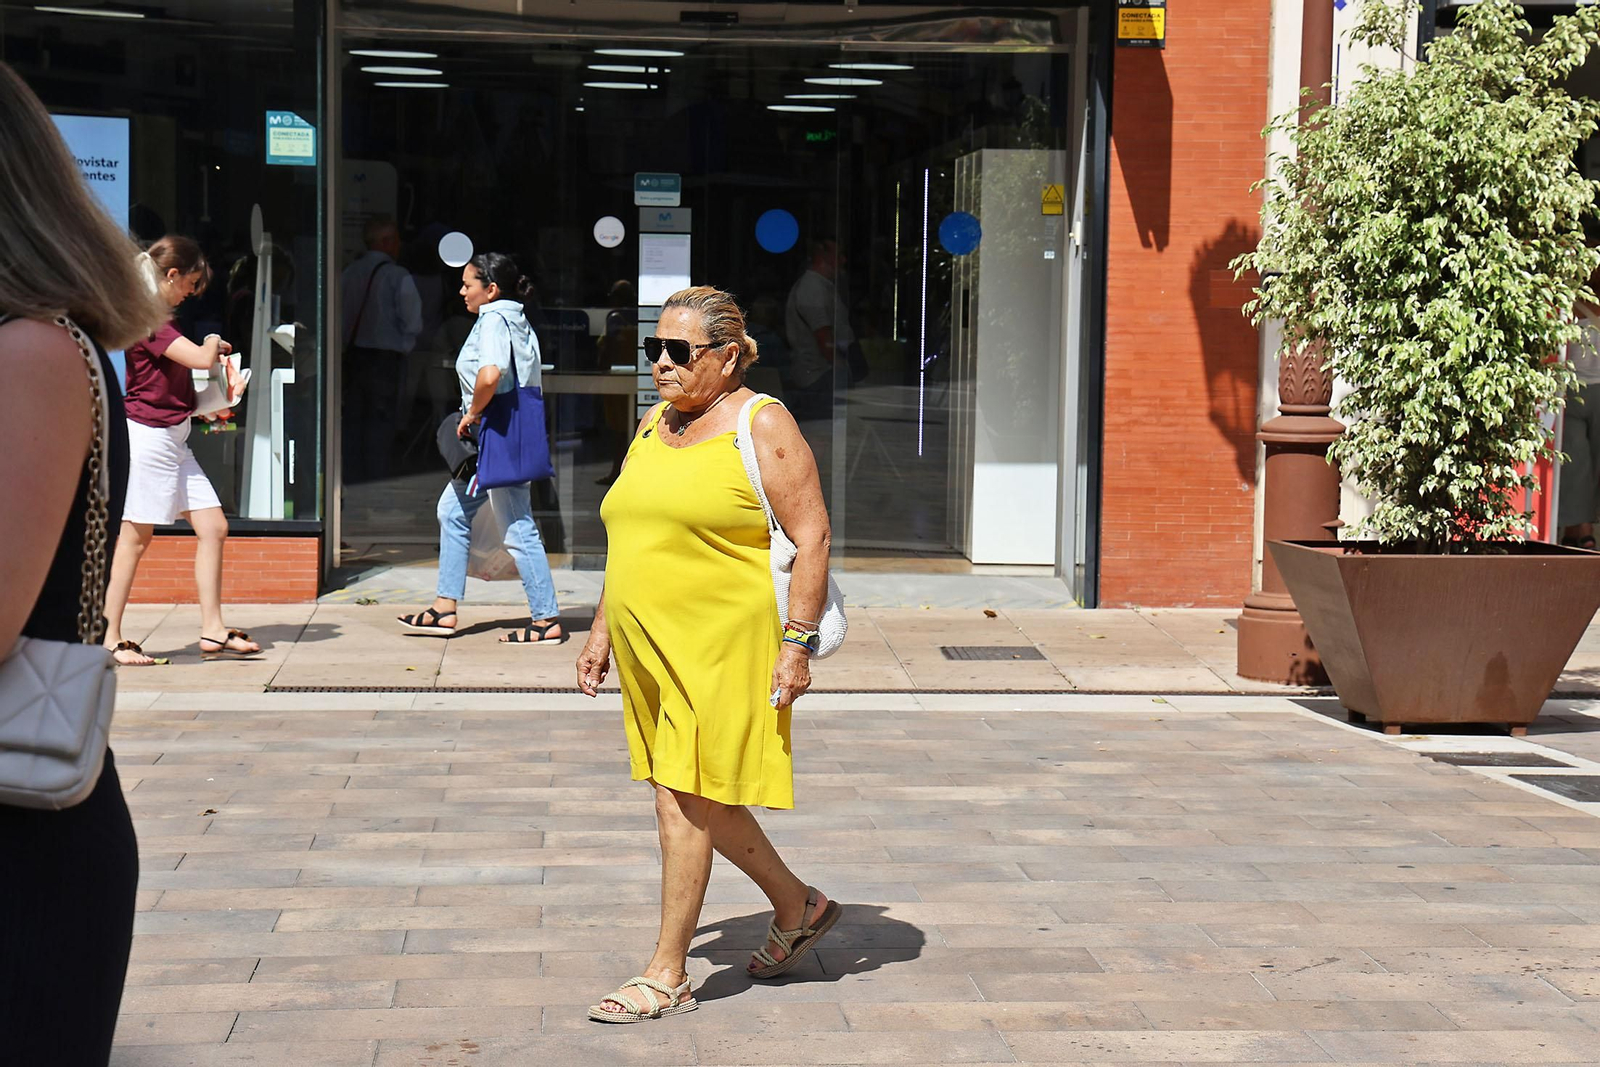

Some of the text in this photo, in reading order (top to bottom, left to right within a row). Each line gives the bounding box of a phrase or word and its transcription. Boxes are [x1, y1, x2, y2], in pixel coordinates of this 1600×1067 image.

[73, 156, 119, 168] ovistar
[83, 171, 116, 182] entes
[599, 233, 619, 242] Google
